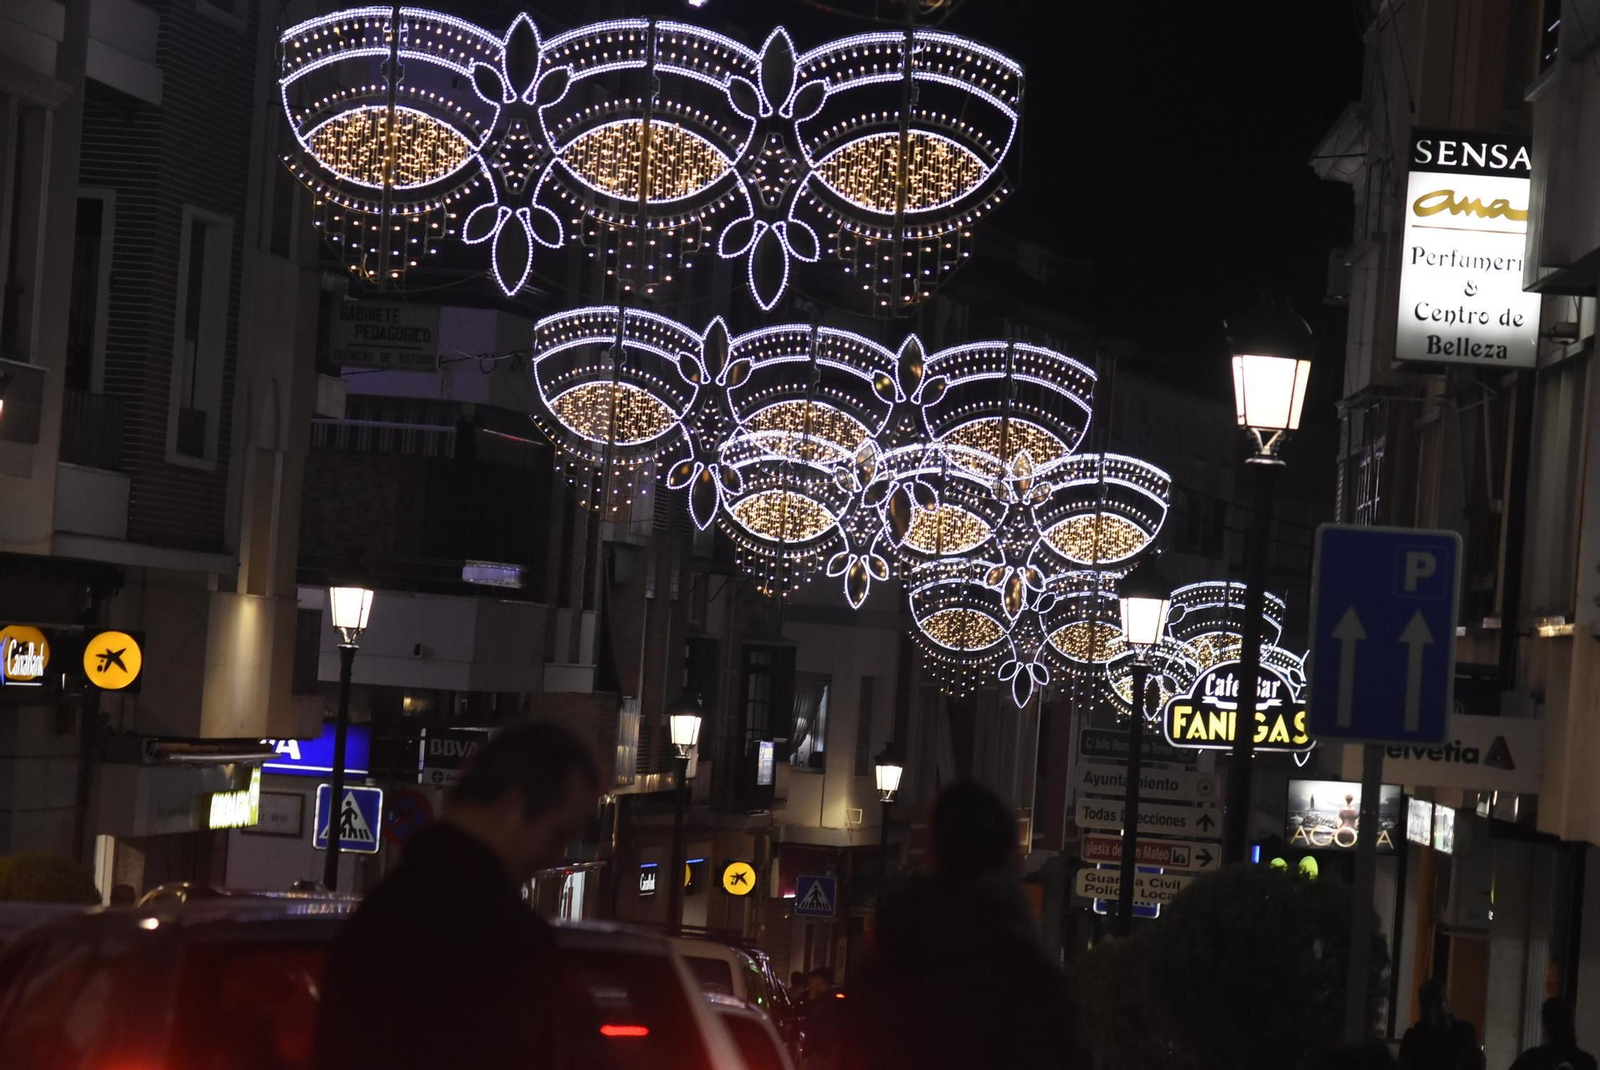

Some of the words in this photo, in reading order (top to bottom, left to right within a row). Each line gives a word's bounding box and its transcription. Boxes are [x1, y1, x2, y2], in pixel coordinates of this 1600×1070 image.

[1414, 139, 1532, 171] SENSA
[1464, 280, 1477, 297] &
[340, 306, 400, 324] GABINETE
[1414, 302, 1490, 327] Centro
[1499, 309, 1524, 328] de
[354, 324, 432, 344] PEDAGOGICO
[1426, 335, 1508, 359] Belleza
[1404, 551, 1437, 592] P
[1383, 739, 1479, 764] elvetia
[1083, 806, 1116, 822] Todas
[1120, 808, 1186, 828] ecciones
[1290, 825, 1395, 850] AGOA
[1111, 844, 1122, 855] de
[1084, 884, 1120, 896] Polic
[1141, 889, 1178, 901] Loca
[1085, 873, 1144, 887] Guara
[1149, 879, 1180, 890] Civil
